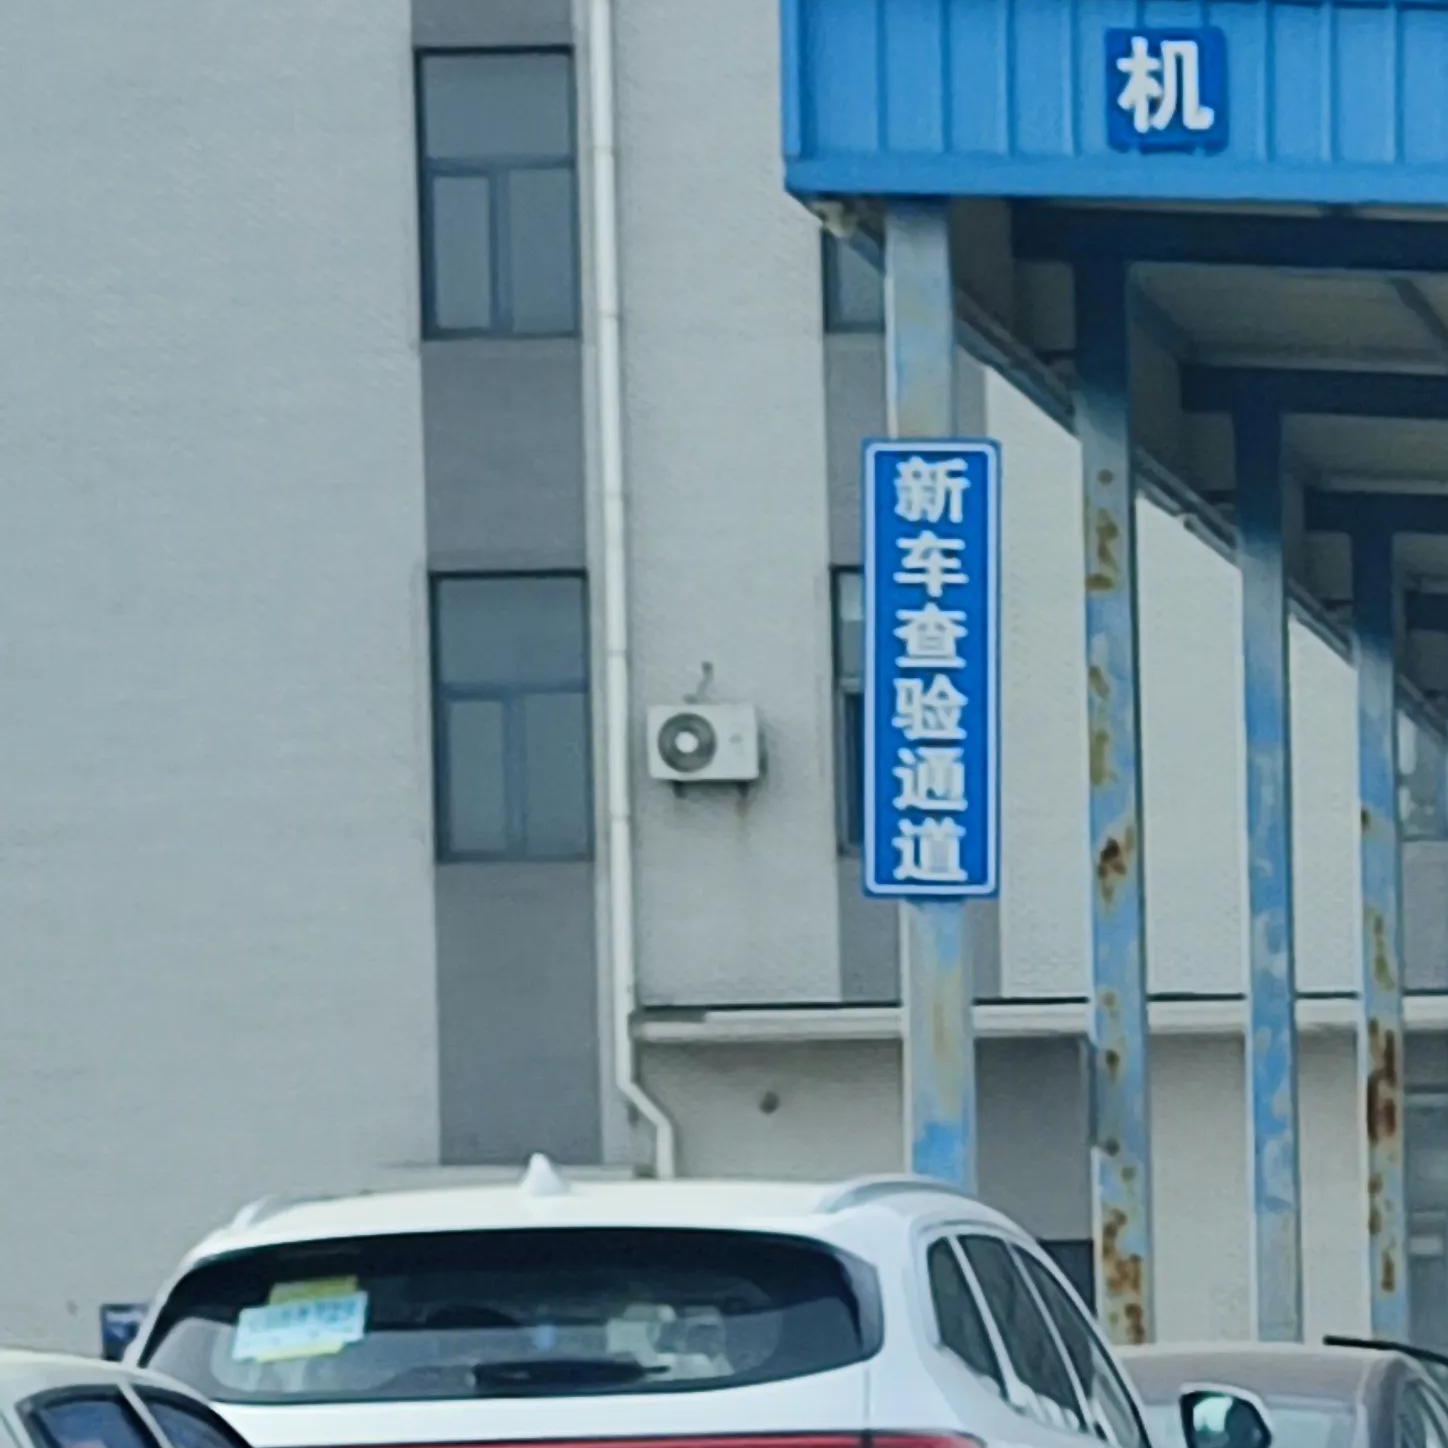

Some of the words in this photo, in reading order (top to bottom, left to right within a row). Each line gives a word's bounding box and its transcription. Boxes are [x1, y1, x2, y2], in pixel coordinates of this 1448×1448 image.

[892, 455, 971, 883] 新车查验通道
